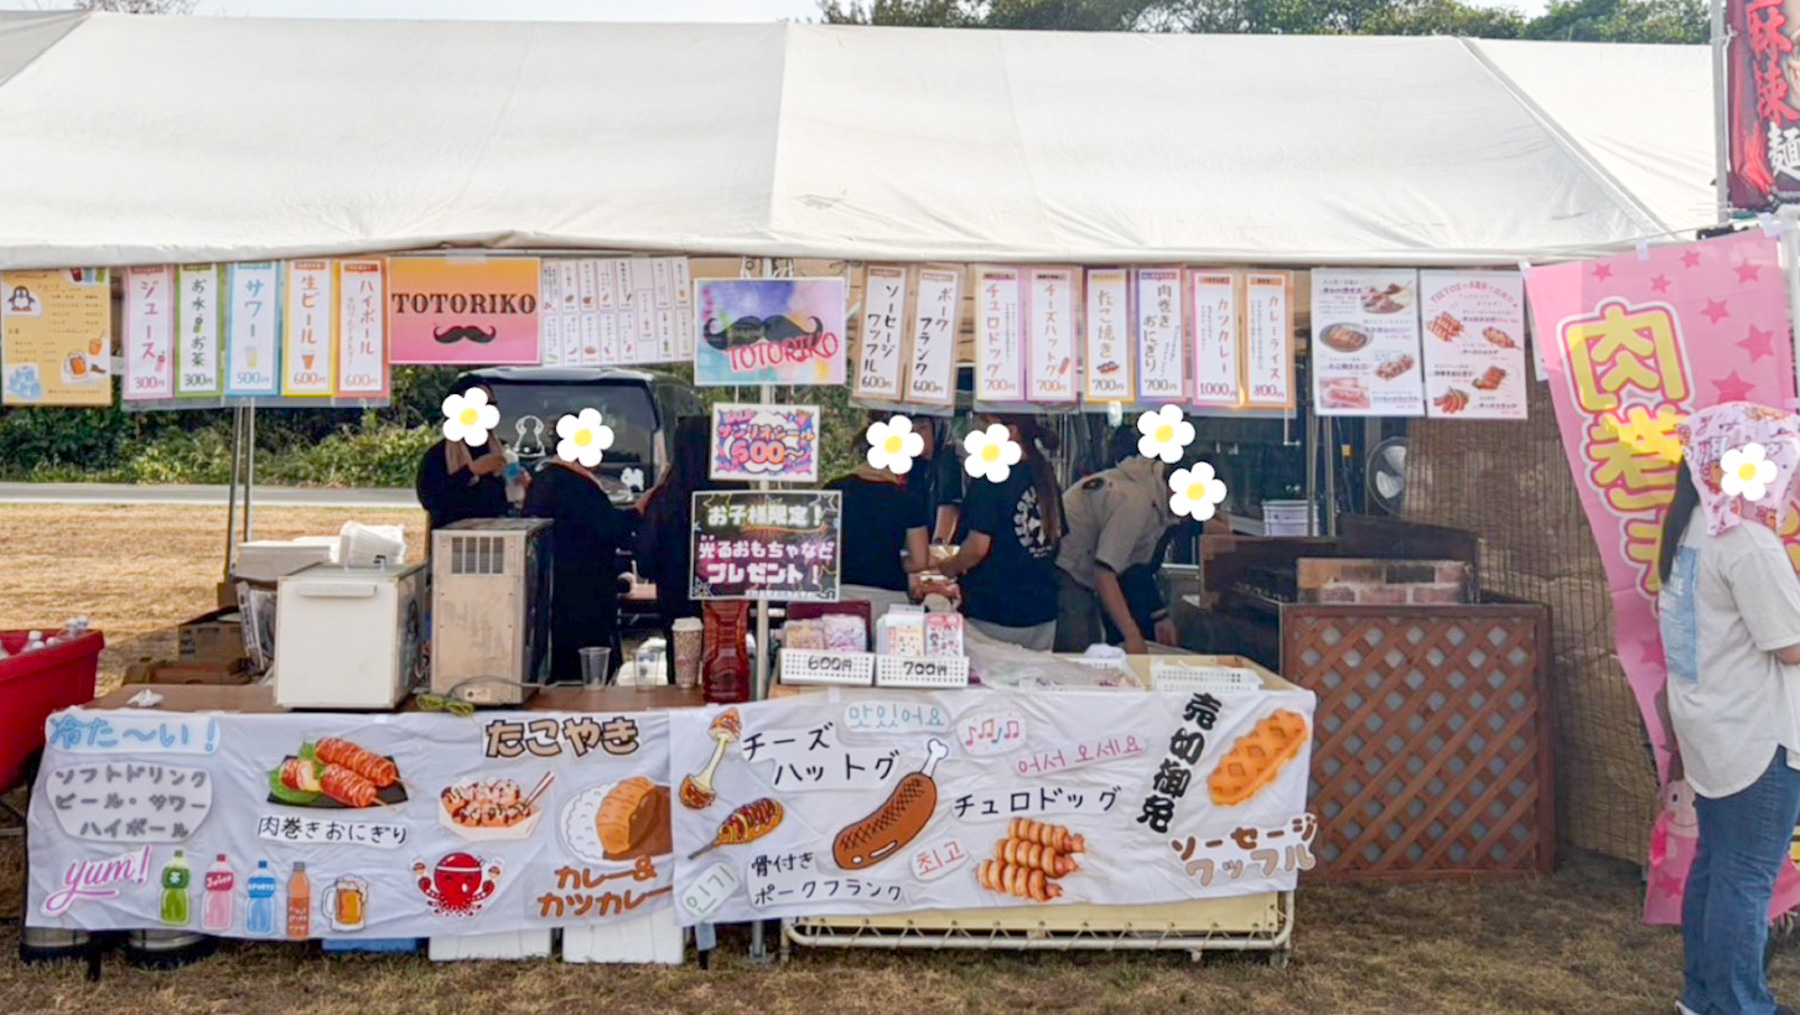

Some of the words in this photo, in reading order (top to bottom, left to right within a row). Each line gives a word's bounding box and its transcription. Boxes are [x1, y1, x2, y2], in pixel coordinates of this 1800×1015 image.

[191, 279, 208, 311] お水
[244, 279, 264, 339] サワー
[301, 275, 320, 346] 生ビール
[392, 293, 537, 314] TOTORIKO
[1157, 284, 1172, 329] 肉巻き
[140, 280, 159, 360] ジュース
[359, 280, 376, 356] ハイボール
[881, 285, 899, 358] ソーセージ
[985, 284, 1003, 378] チュロドッグ
[1045, 284, 1059, 378] チーズハットグ
[1097, 289, 1116, 359] たこ焼き
[1218, 298, 1230, 374] カツカレー
[1269, 296, 1281, 381] カレーライス
[727, 332, 838, 371] TOTORIKO
[864, 314, 882, 373] ワッフル
[915, 318, 933, 376] フランク
[1143, 315, 1159, 373] おにぎり
[134, 374, 166, 389] 300円
[183, 373, 214, 387] 300円
[699, 541, 835, 560] 光るおもちゃなど
[485, 716, 640, 758] たこやき
[743, 721, 834, 762] チーズ
[56, 764, 207, 789] ソフトドリンク
[774, 749, 900, 786] ハットグ
[953, 785, 1122, 818] チュロドッグ
[80, 818, 189, 839] ハイボール
[258, 814, 408, 845] 肉巻きおにぎり
[1171, 814, 1319, 862] ソーセージ
[46, 844, 152, 912] yum!
[751, 852, 814, 878] 骨付き
[1185, 843, 1316, 887] ワッフル
[536, 886, 676, 918] カツカレー
[754, 879, 903, 906] ポークフランク
